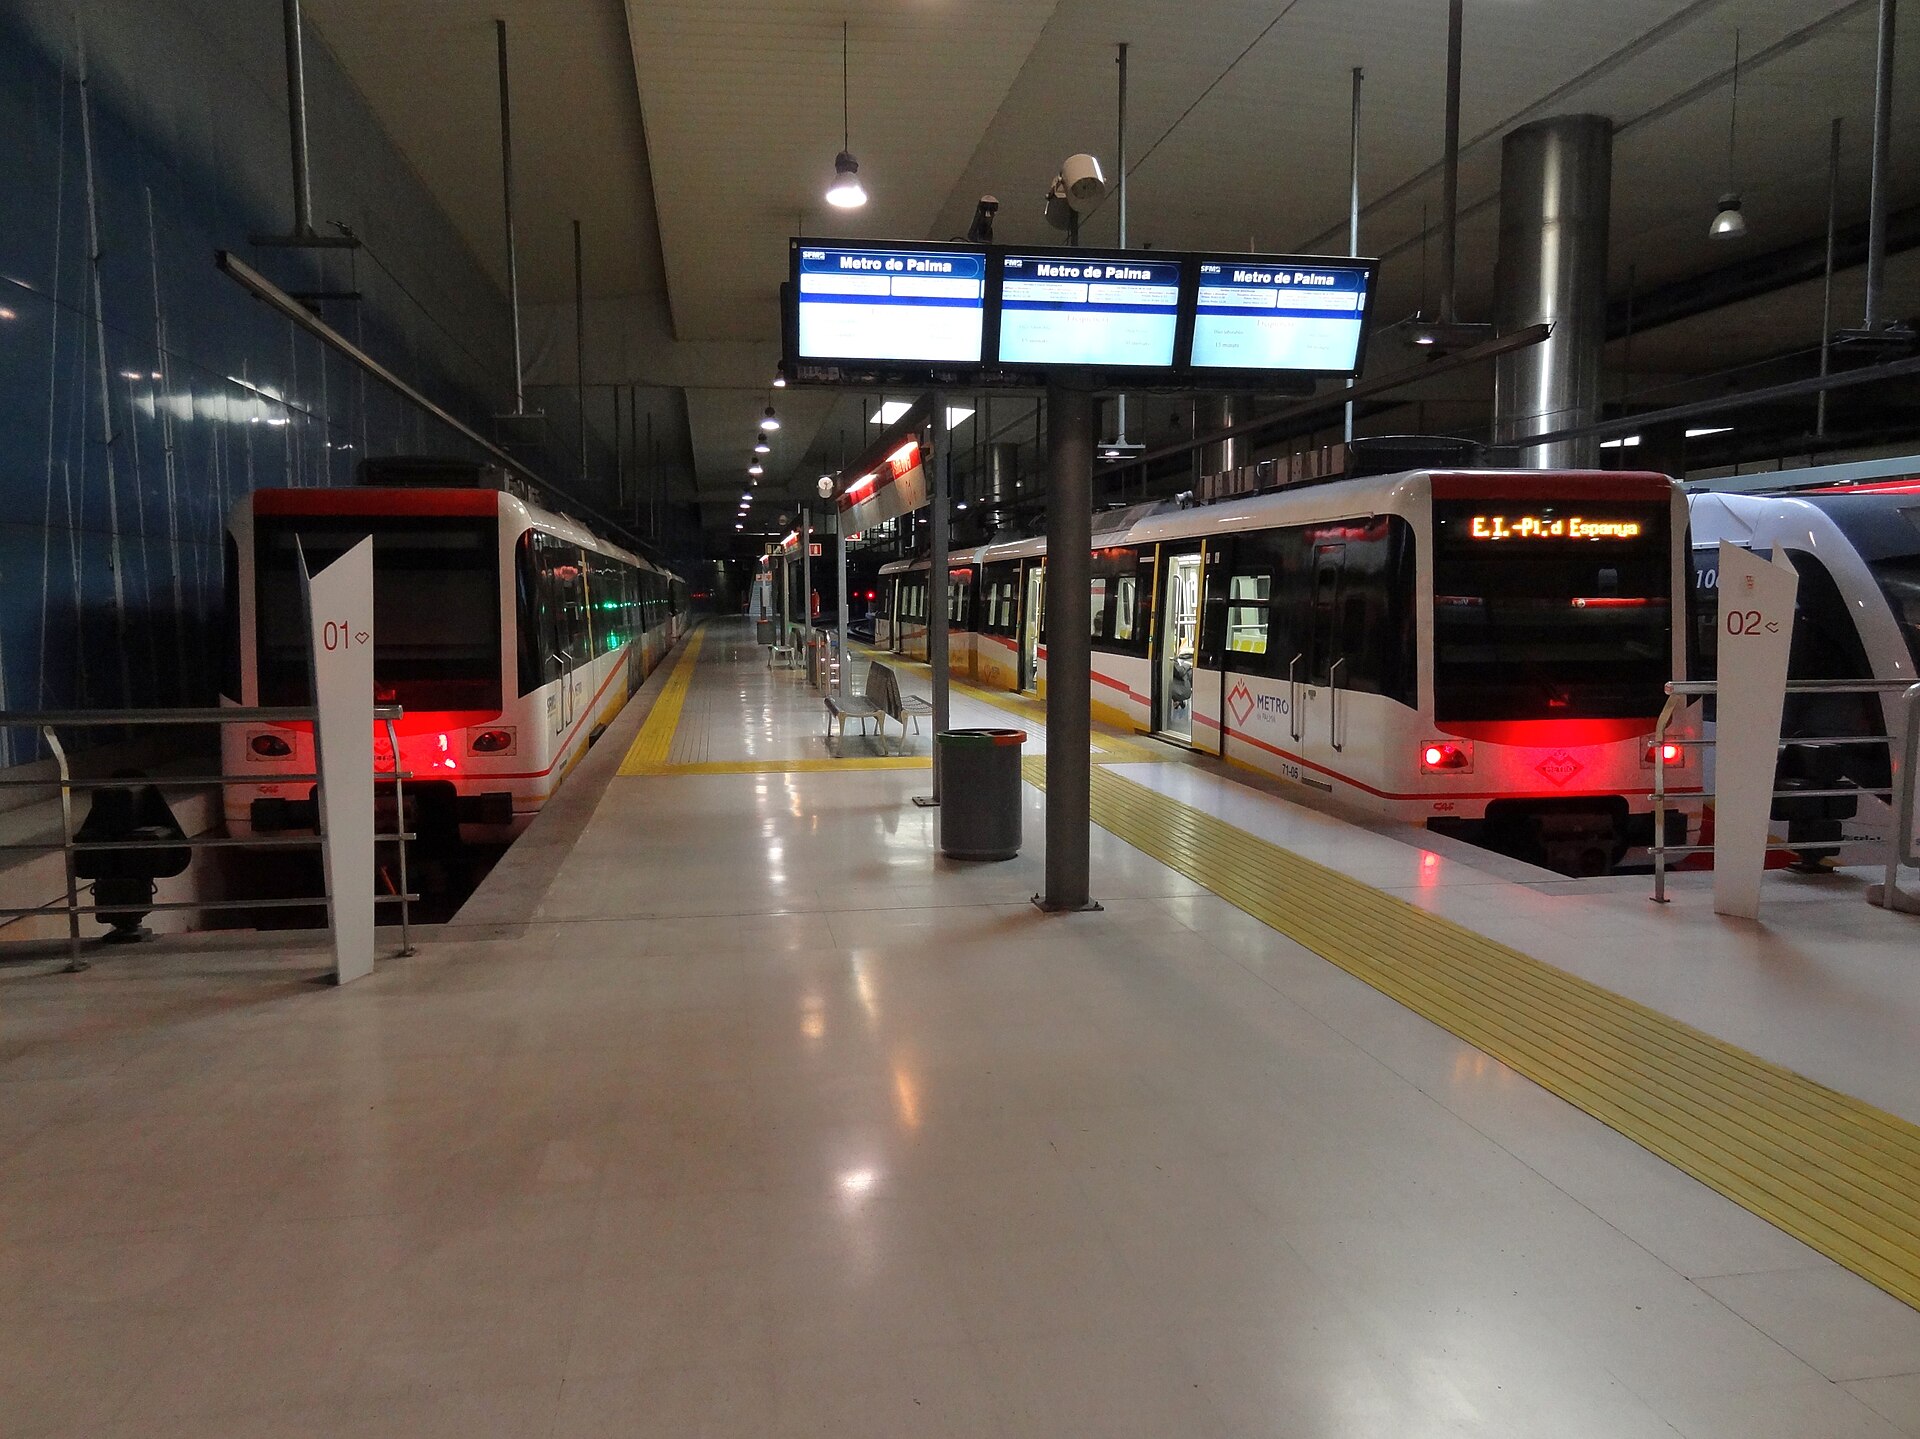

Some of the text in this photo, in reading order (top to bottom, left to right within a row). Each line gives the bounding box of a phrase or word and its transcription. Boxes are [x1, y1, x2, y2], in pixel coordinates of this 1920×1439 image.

[840, 256, 953, 273] Metro de Palma
[1037, 264, 1151, 280] Metro de Palma
[1233, 270, 1335, 286] Metro de Palma
[1569, 517, 1638, 537] Espanya
[1695, 568, 1720, 589] 10
[1726, 610, 1762, 636] 02
[323, 620, 350, 651] 01
[1256, 694, 1290, 715] METRO
[1281, 763, 1299, 780] 71-05
